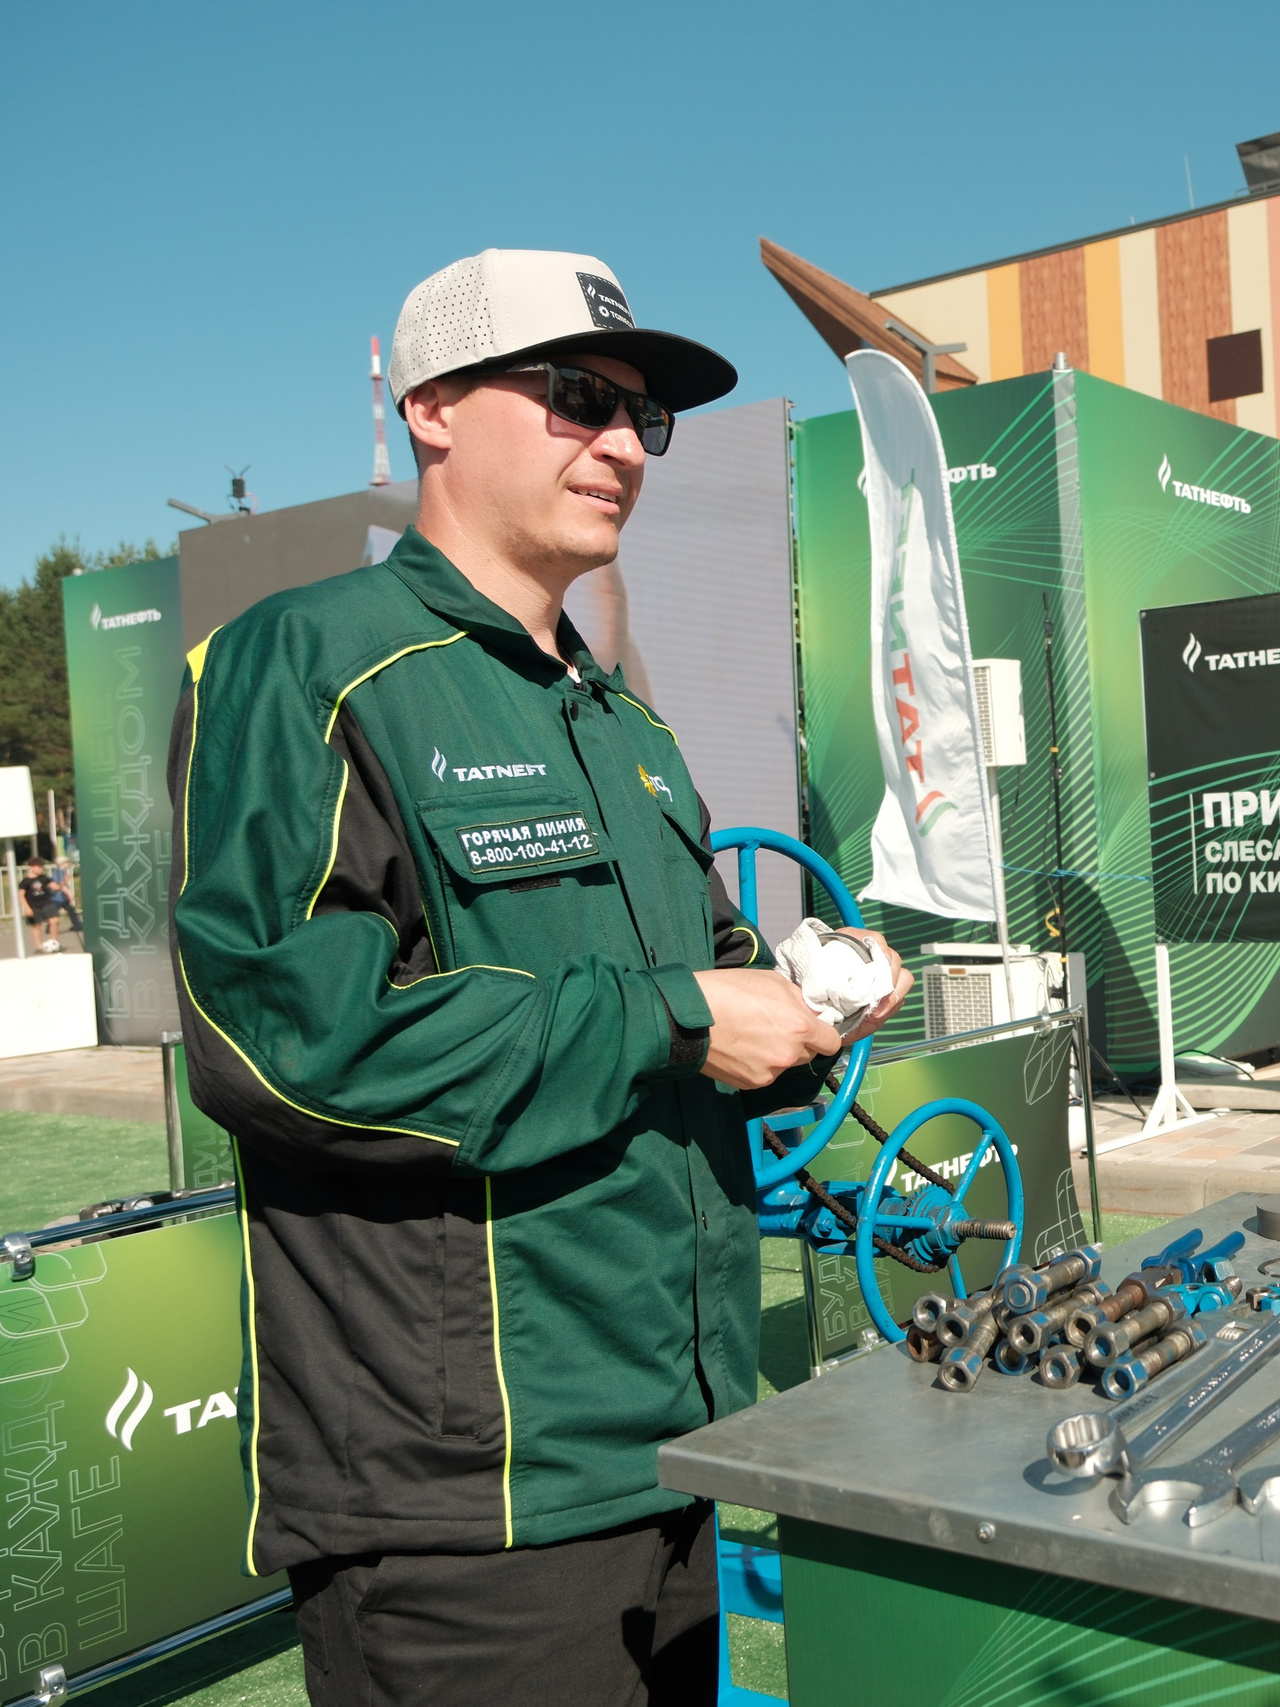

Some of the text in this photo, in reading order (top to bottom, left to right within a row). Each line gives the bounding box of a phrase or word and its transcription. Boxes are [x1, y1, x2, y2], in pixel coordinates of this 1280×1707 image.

[1172, 480, 1251, 514] ТАТНЕФТЬ
[101, 608, 162, 631] ТАТНЕФТЬ
[453, 764, 547, 782] TATNEFT
[461, 817, 587, 850] ГОРЯЧАЯ ЛИНИЯ
[470, 834, 593, 866] 8-800-100-41-12
[1206, 872, 1242, 894] ПО
[69, 1455, 128, 1651] ШАГЕ
